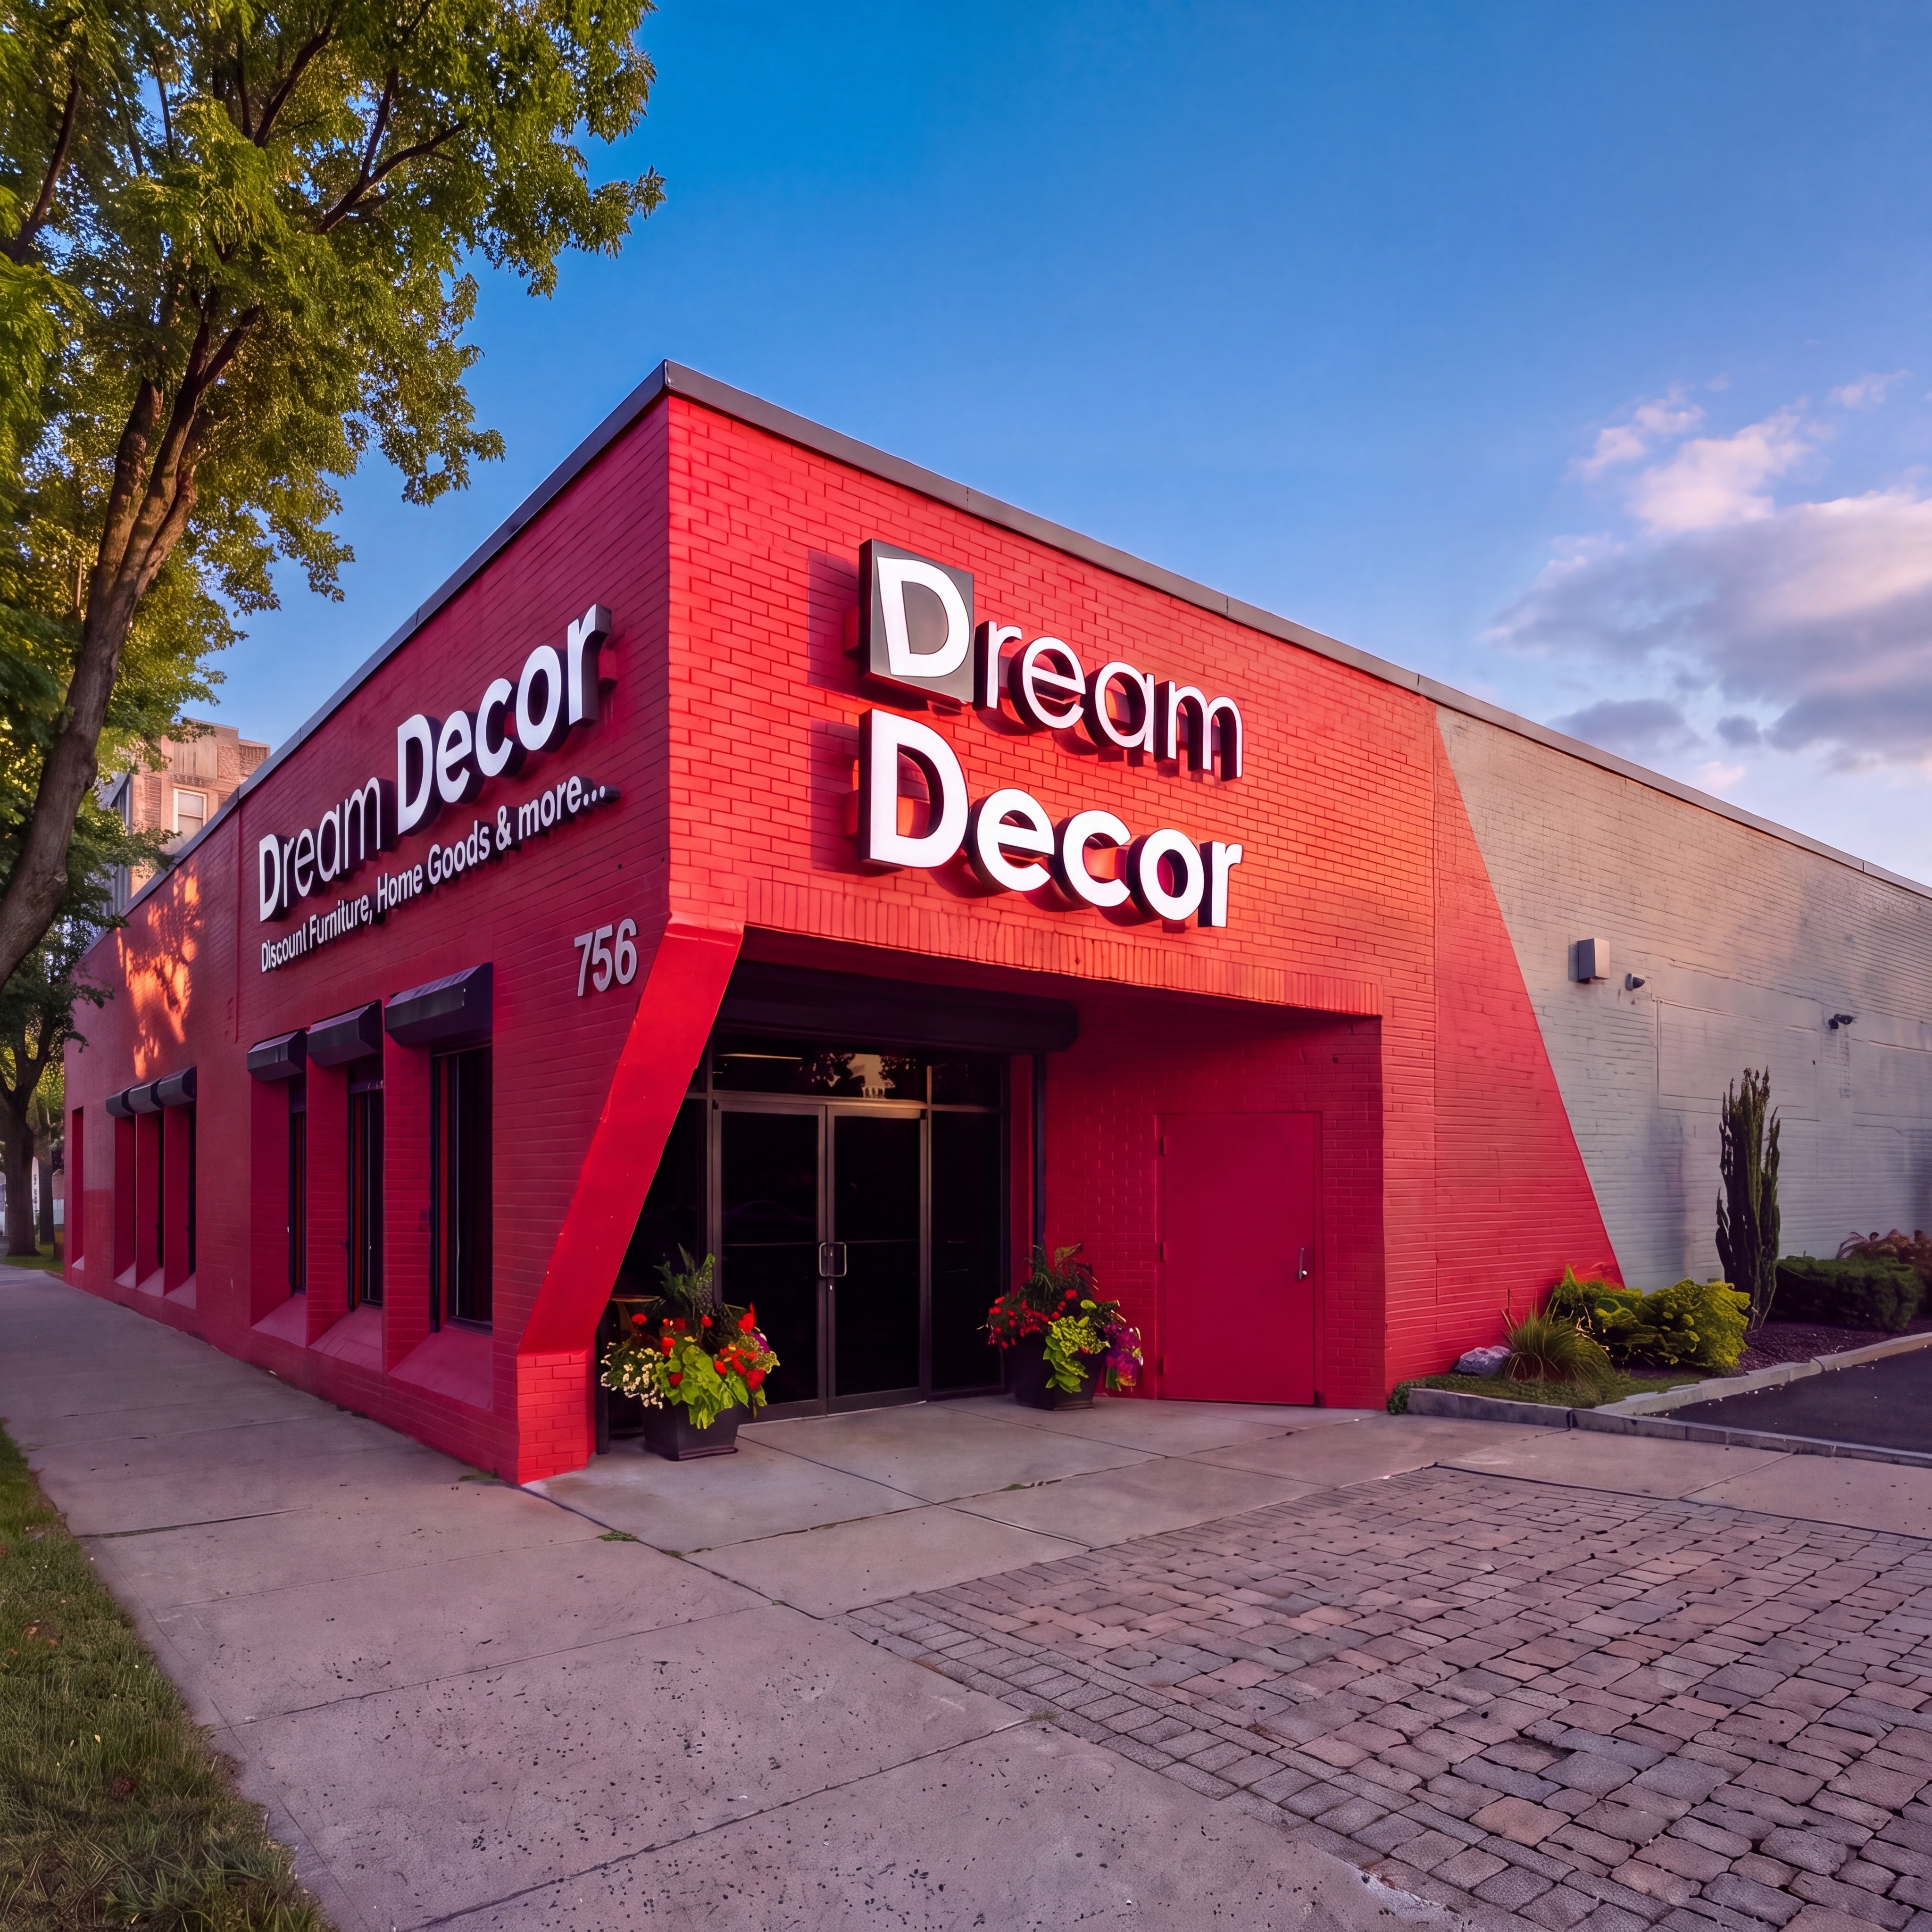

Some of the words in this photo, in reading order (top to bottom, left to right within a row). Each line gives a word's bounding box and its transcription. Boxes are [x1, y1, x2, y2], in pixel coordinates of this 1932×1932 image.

[259, 776, 381, 922] Dream
[397, 603, 597, 835] Decor
[876, 555, 1243, 778] Dream
[261, 939, 307, 973] Discount
[309, 894, 373, 925] Furniture,
[377, 864, 423, 913] Home
[428, 819, 491, 885] Goods
[495, 805, 512, 851] &
[518, 775, 606, 841] more...
[870, 708, 1243, 928] Decor
[574, 918, 637, 997] 756
